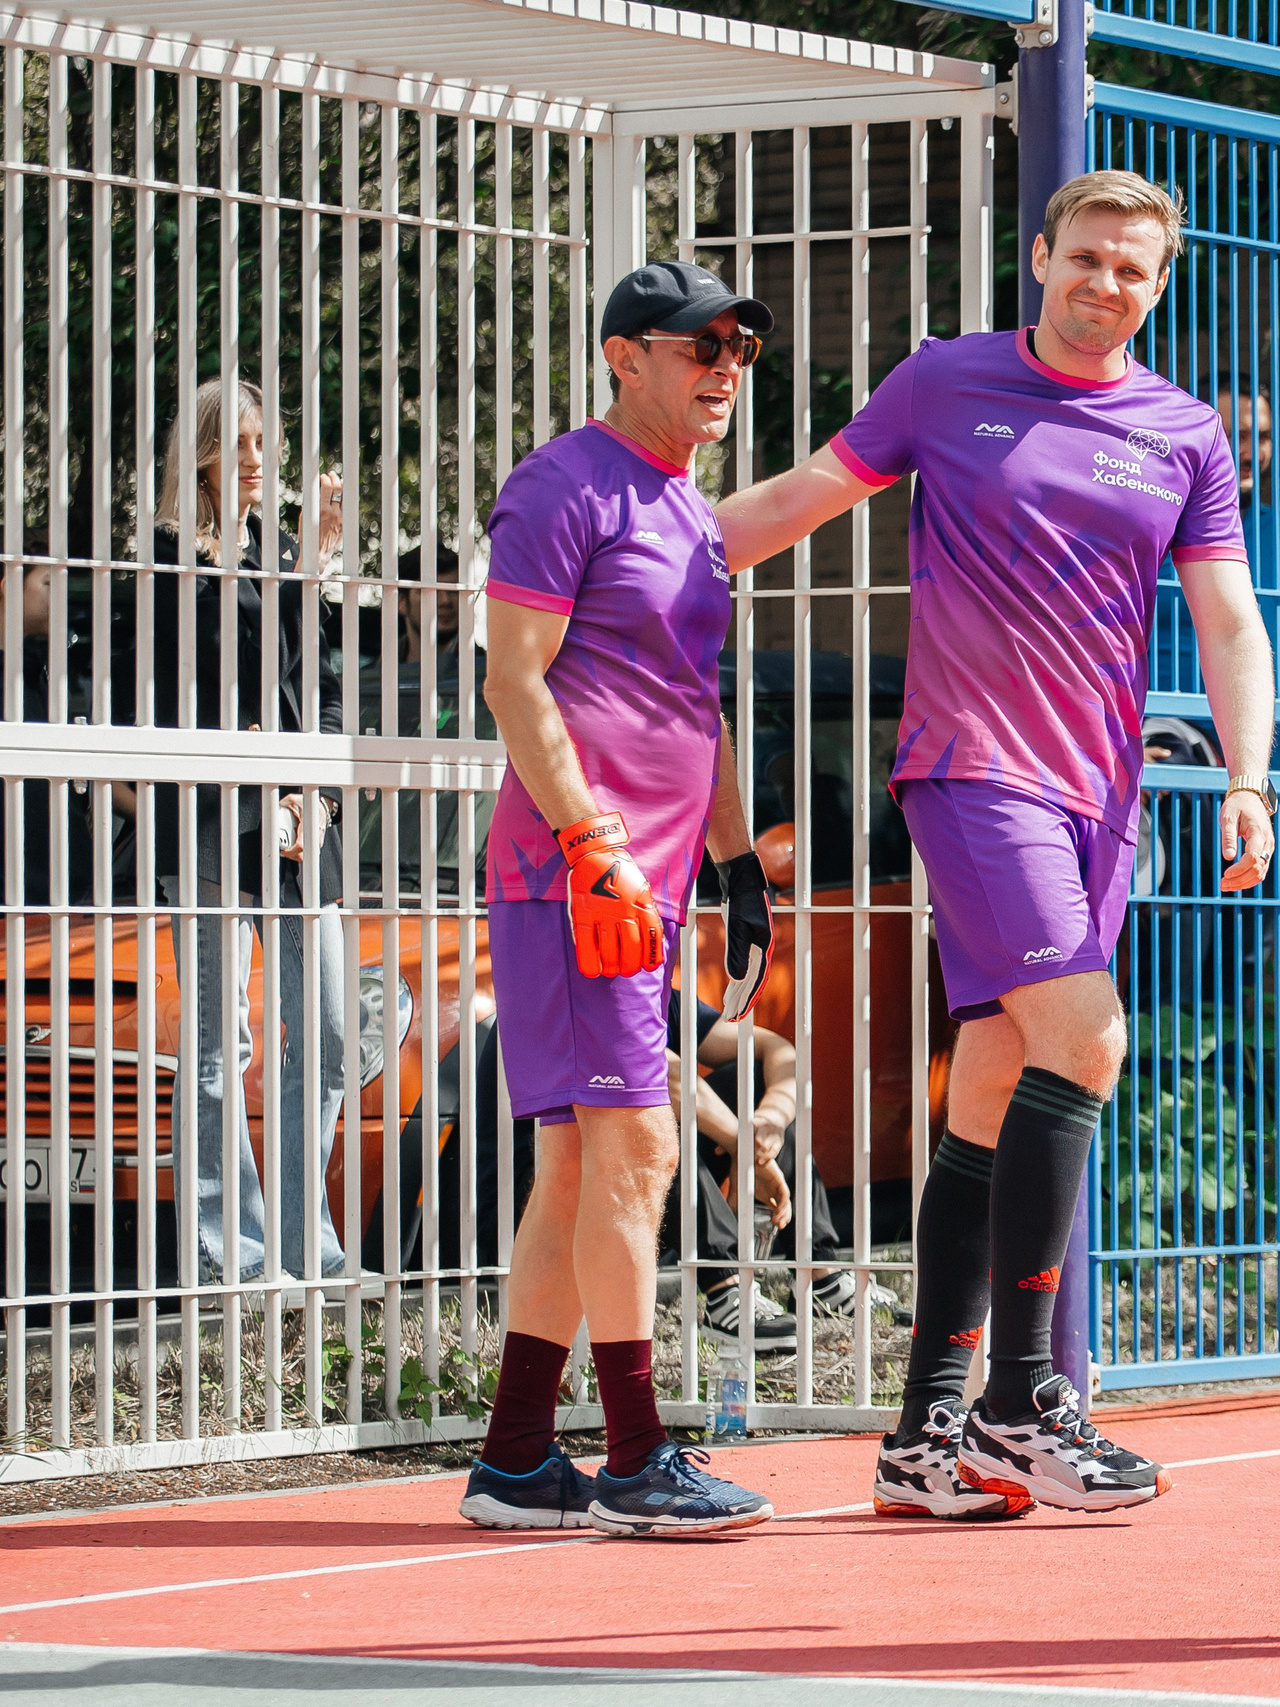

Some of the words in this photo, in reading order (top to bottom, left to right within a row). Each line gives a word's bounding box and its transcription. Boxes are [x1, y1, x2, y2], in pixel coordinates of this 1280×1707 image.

[1093, 450, 1142, 476] Фонд
[1091, 468, 1183, 507] Хабенского
[566, 822, 621, 851] DEMIX
